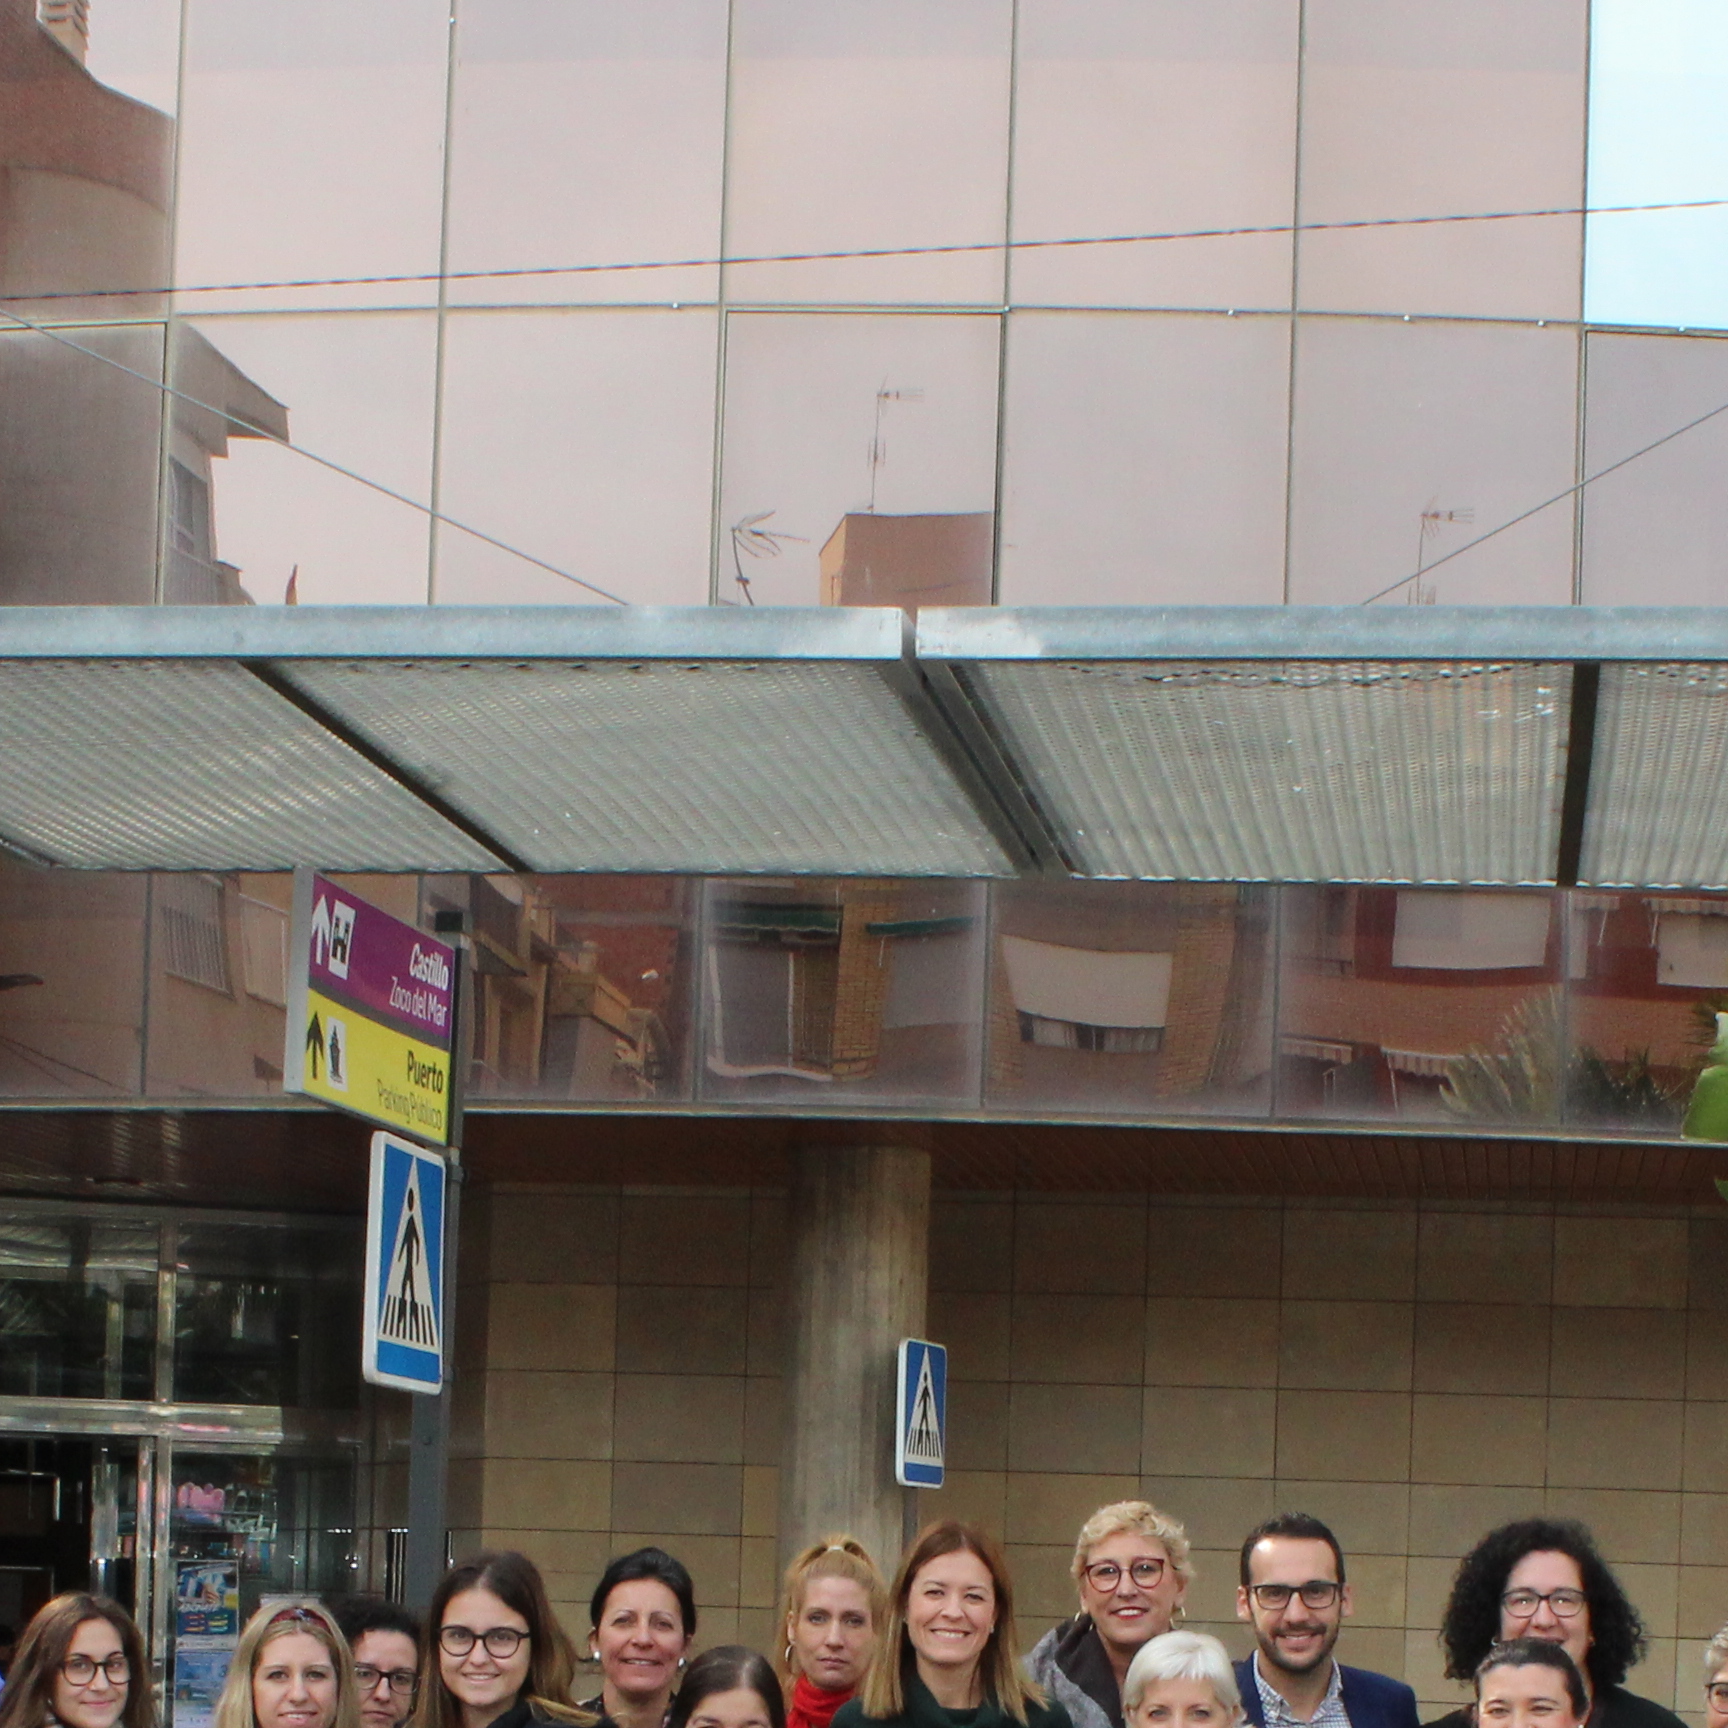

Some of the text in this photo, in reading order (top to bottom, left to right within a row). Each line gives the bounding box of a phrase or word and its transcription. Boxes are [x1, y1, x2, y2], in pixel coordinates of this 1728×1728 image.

[409, 943, 449, 991] Castillo
[390, 976, 447, 1027] Zoco del Mar
[407, 1050, 444, 1094] Puerto
[377, 1078, 410, 1124] Parking
